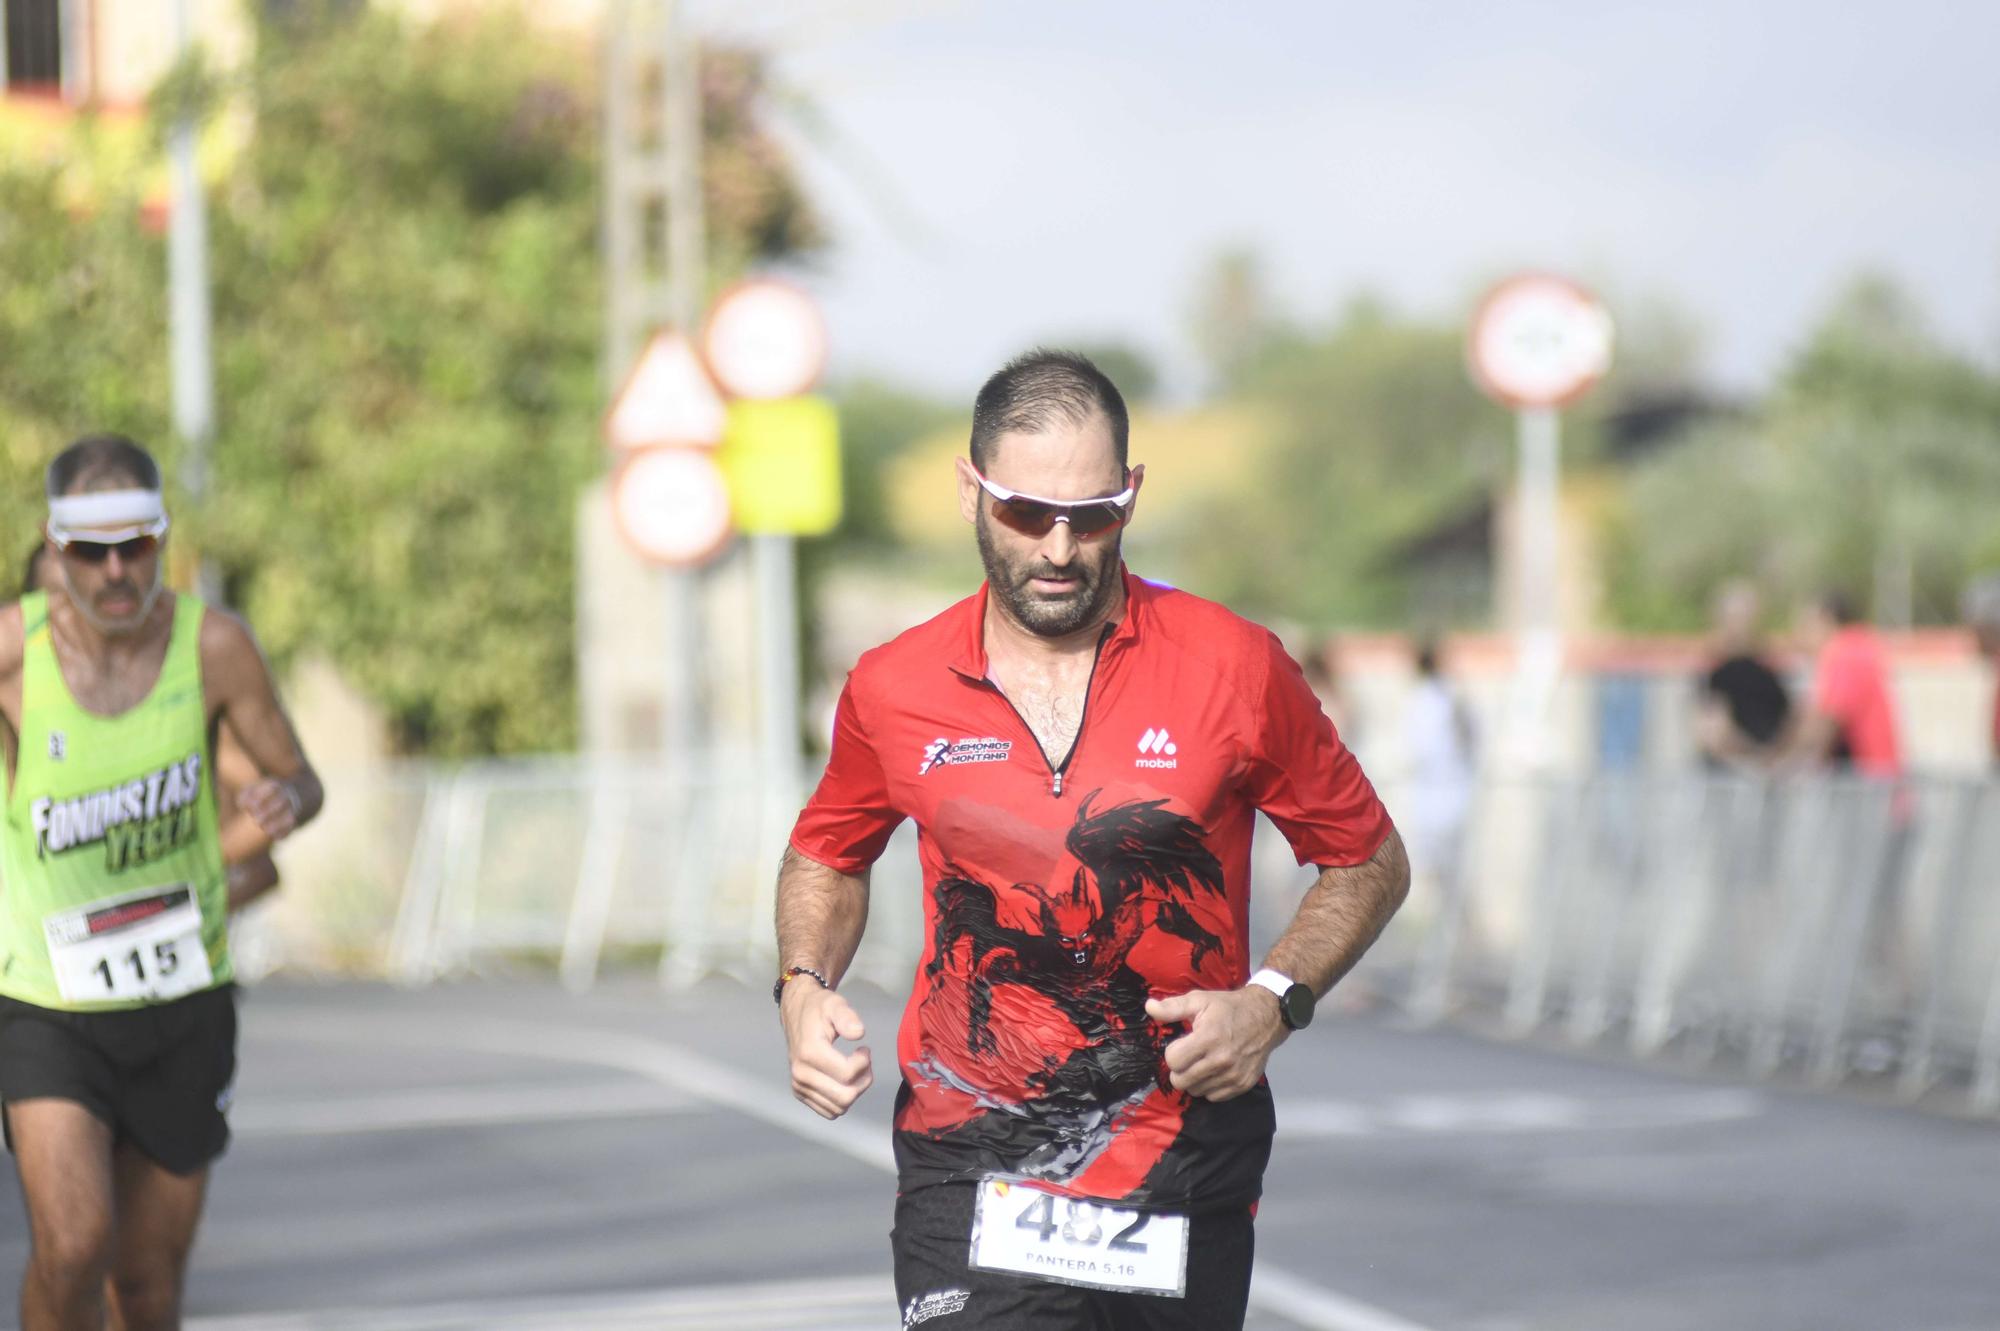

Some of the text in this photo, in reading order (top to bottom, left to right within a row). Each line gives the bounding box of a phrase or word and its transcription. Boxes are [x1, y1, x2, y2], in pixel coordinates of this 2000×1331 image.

[951, 742, 1010, 753] DEMONIOS
[1135, 759, 1177, 769] mobel
[31, 752, 201, 857] FONDISTAS
[93, 941, 177, 989] 115
[1015, 1194, 1148, 1254] 482
[1026, 1252, 1136, 1276] PANTERA 5.16
